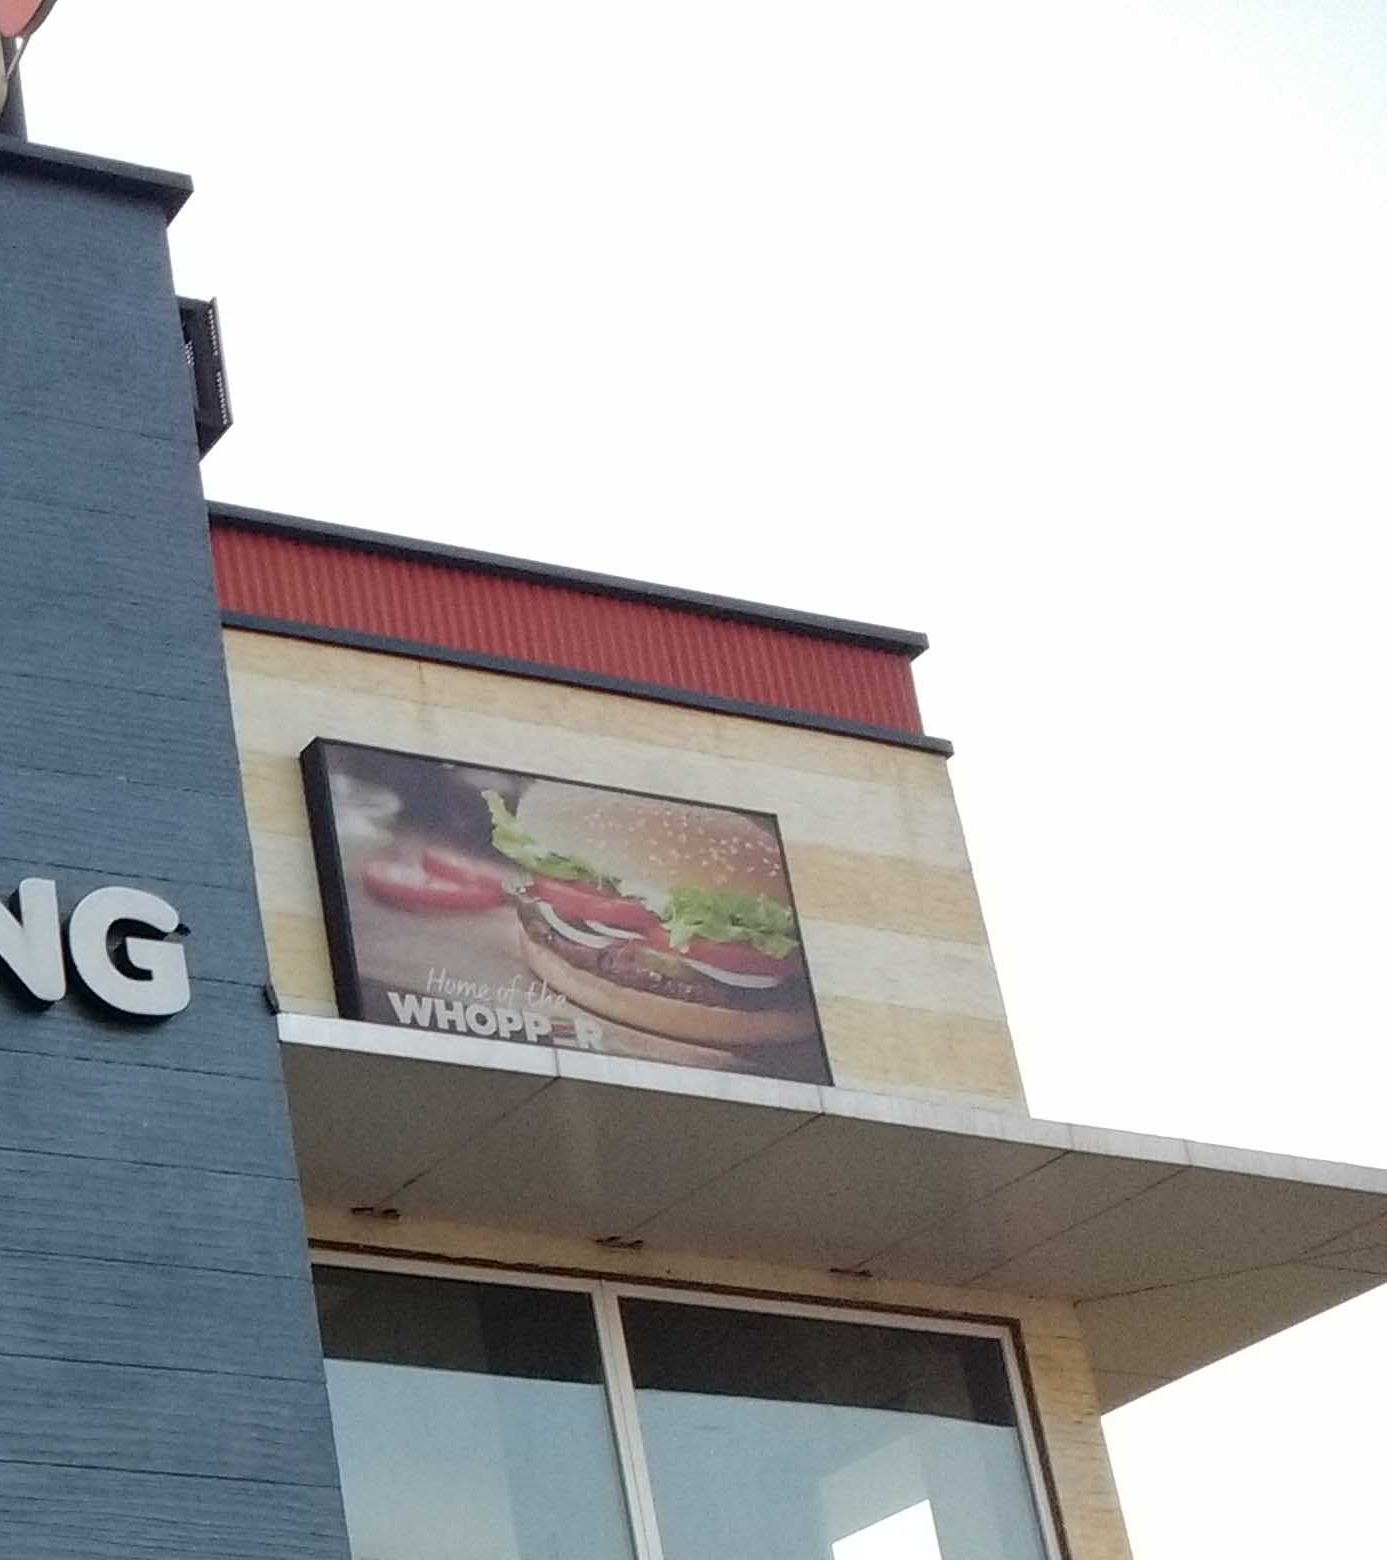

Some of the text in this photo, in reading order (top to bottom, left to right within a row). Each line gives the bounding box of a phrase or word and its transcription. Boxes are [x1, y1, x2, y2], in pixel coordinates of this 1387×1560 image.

[427, 967, 567, 1009] Home of the
